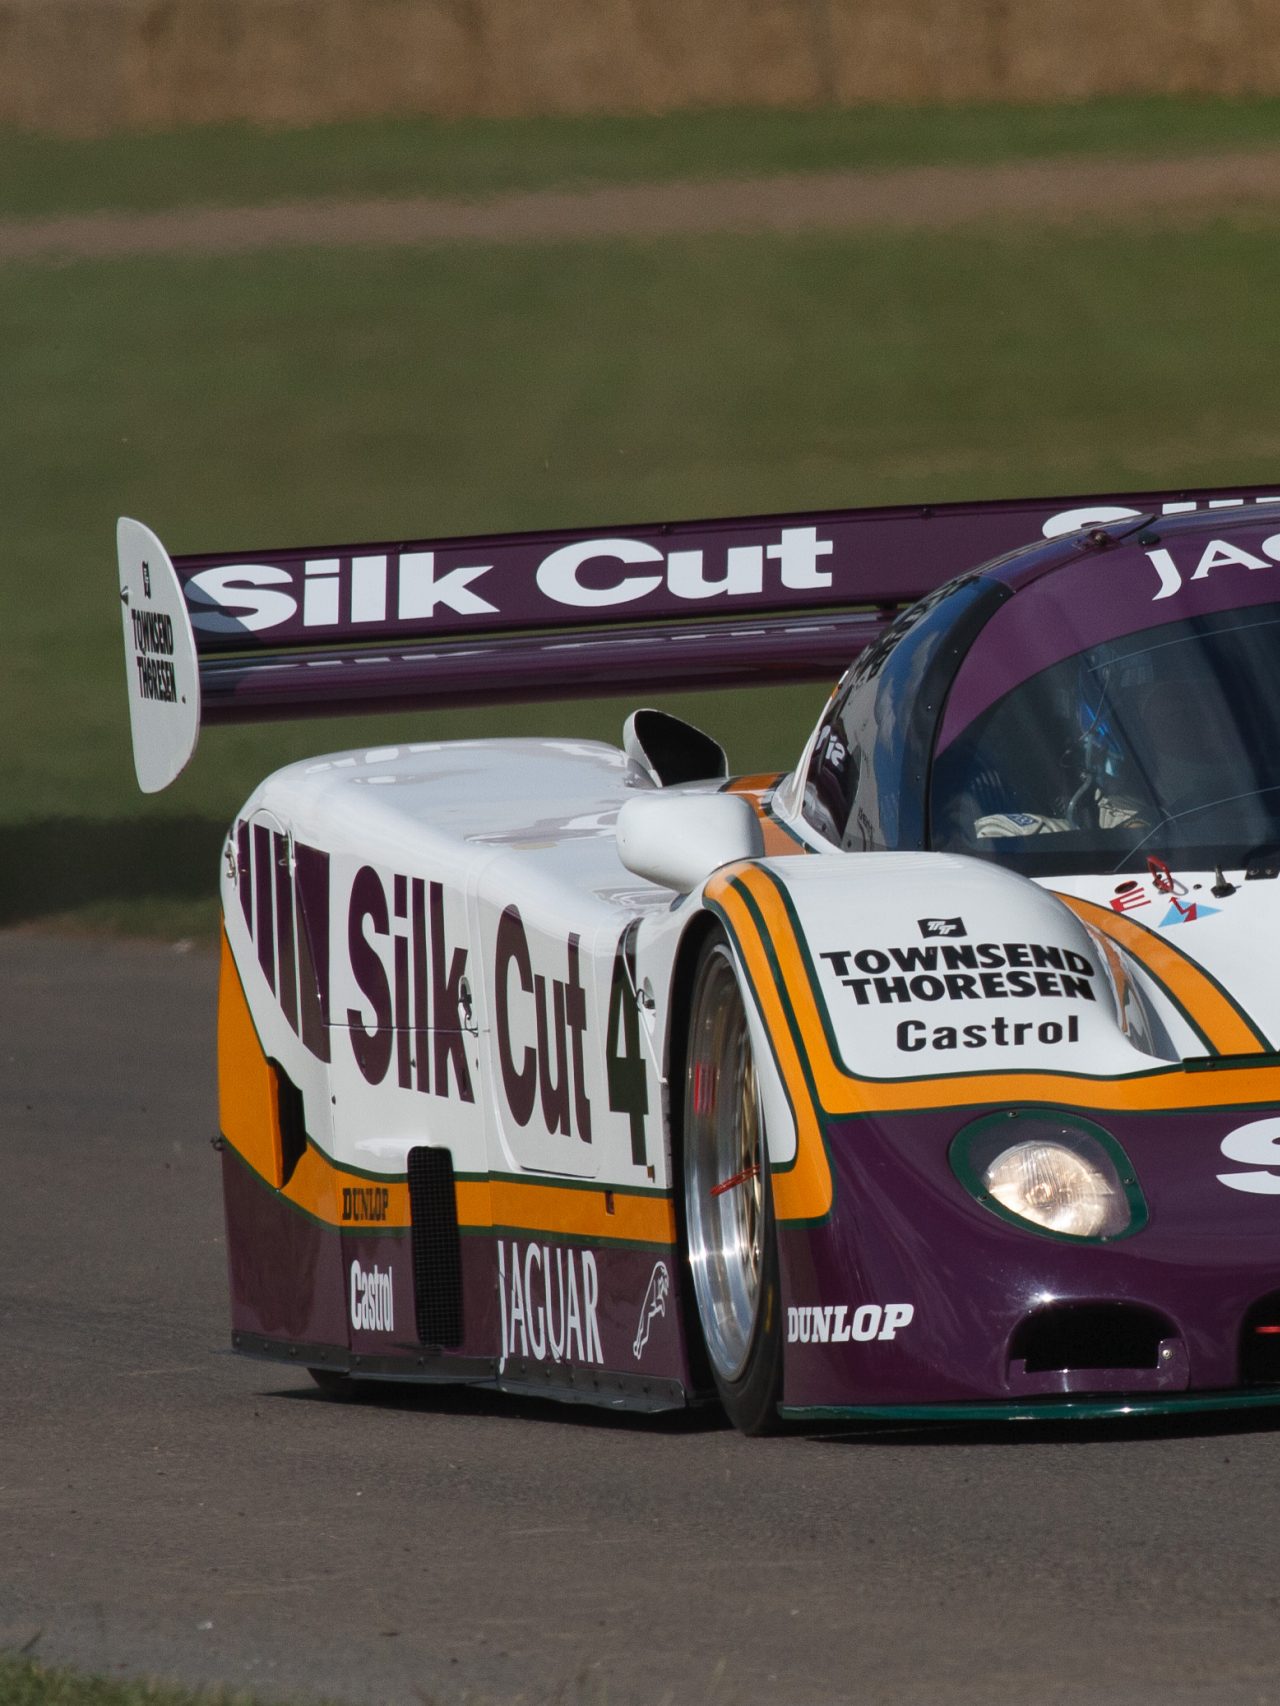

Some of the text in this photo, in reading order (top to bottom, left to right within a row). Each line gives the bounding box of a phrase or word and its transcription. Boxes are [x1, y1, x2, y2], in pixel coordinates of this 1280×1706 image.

[184, 552, 500, 633] Silk
[536, 526, 834, 607] Cut
[131, 608, 174, 656] TOWNSEND
[136, 656, 177, 703] THORESEN
[819, 943, 1095, 977] TOWNSEND
[842, 970, 1097, 1005] THORESEN
[346, 864, 650, 1166] Silk Cut 4
[896, 1015, 1079, 1052] Castrol
[342, 1187, 389, 1221] DUNLOP
[350, 1259, 395, 1332] Castrol
[497, 1240, 605, 1375] JAGUAR
[787, 1303, 914, 1344] DUNLOP
